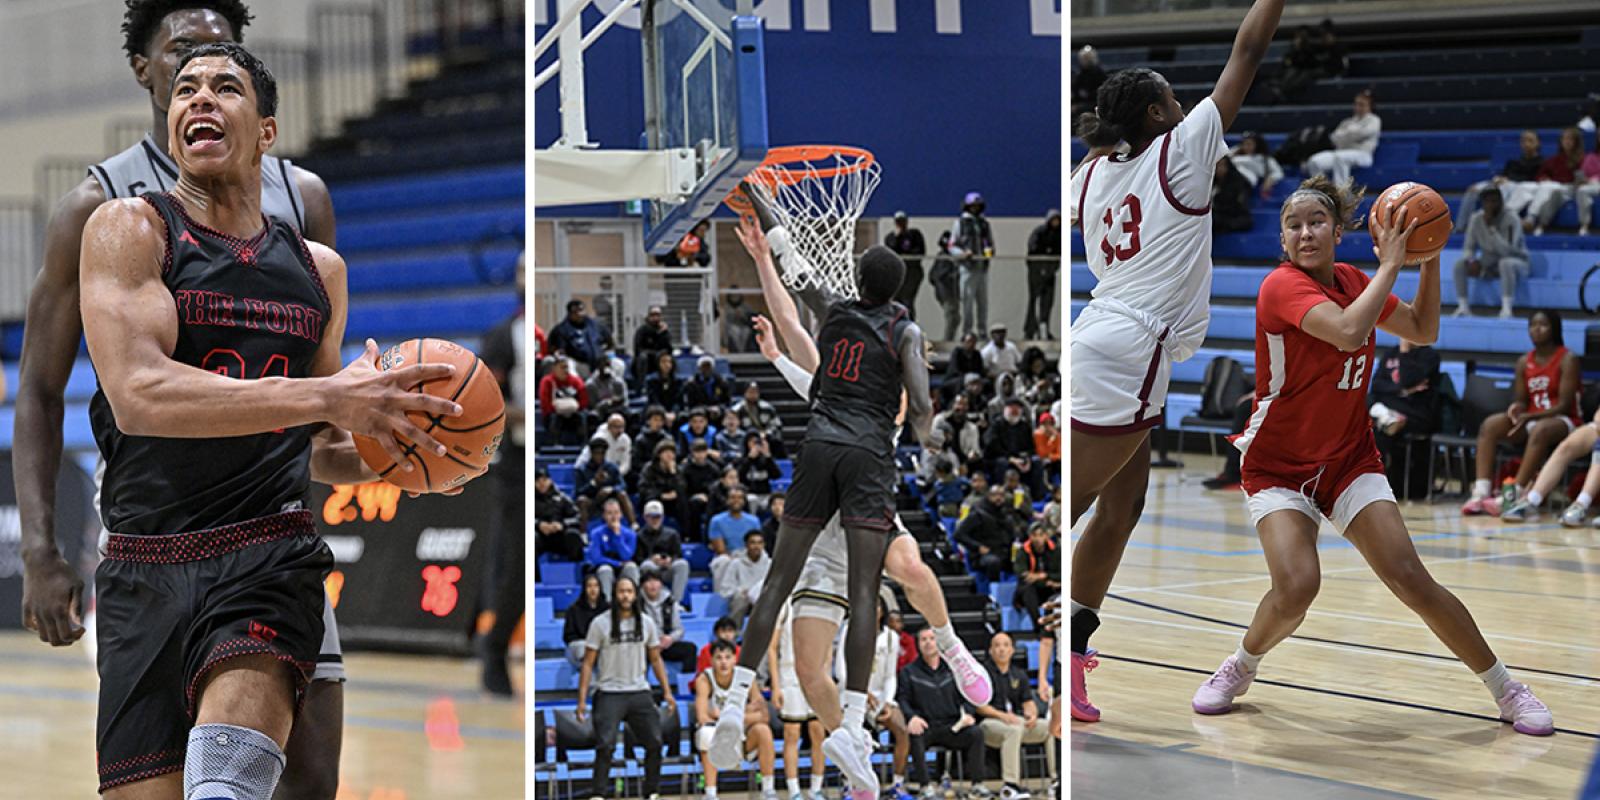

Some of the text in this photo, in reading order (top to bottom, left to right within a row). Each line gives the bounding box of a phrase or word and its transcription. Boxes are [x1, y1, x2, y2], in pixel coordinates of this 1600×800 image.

[1101, 193, 1142, 266] 13
[176, 289, 321, 344] THE FORT
[825, 338, 865, 382] 11
[1337, 354, 1367, 390] 12
